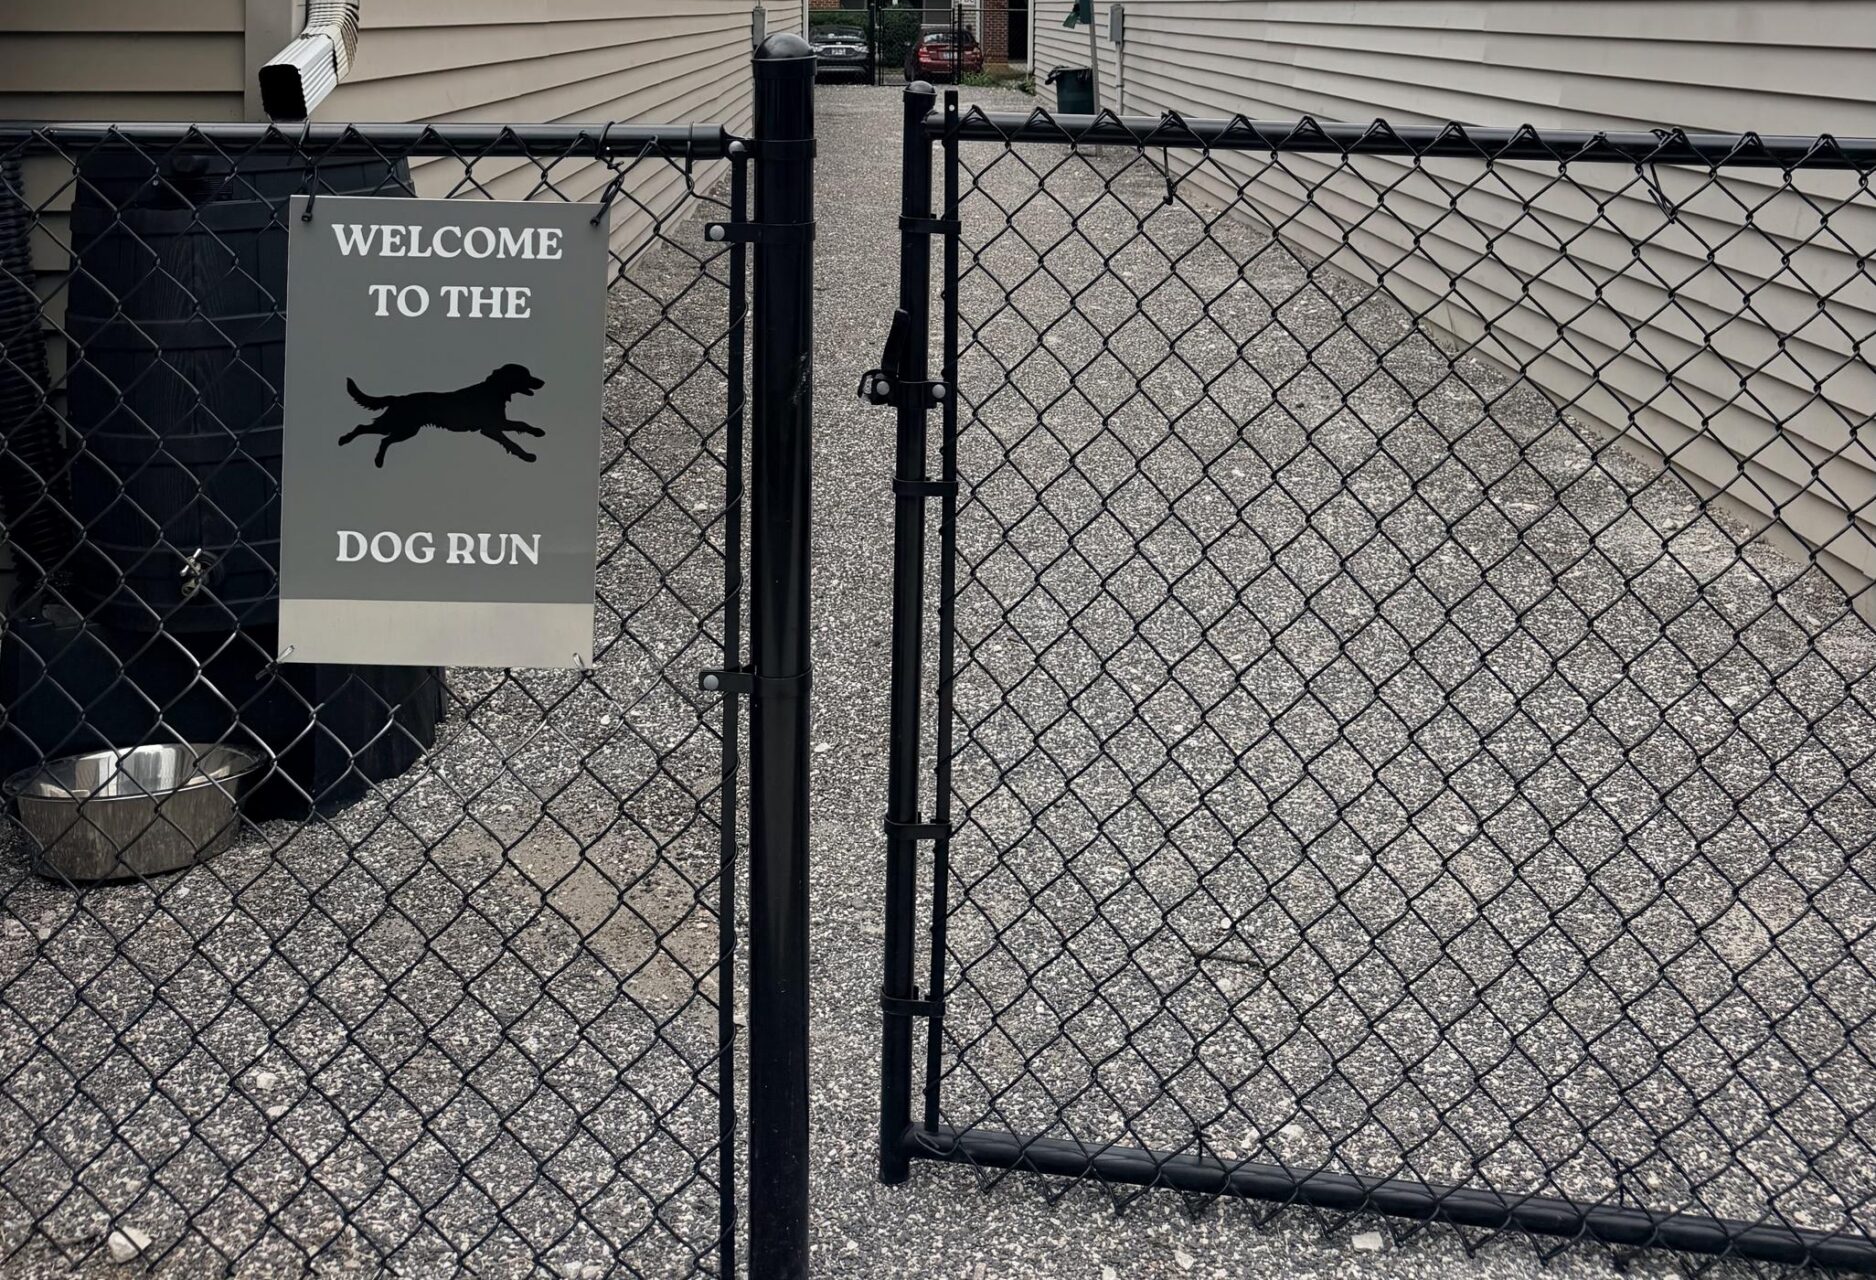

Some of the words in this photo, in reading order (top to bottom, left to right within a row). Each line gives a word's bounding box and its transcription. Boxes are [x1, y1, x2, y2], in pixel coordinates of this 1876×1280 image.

[331, 223, 563, 260] WELCOME
[368, 284, 430, 318] TO
[440, 285, 532, 319] THE
[335, 530, 436, 564] DOG
[445, 532, 542, 565] RUN
